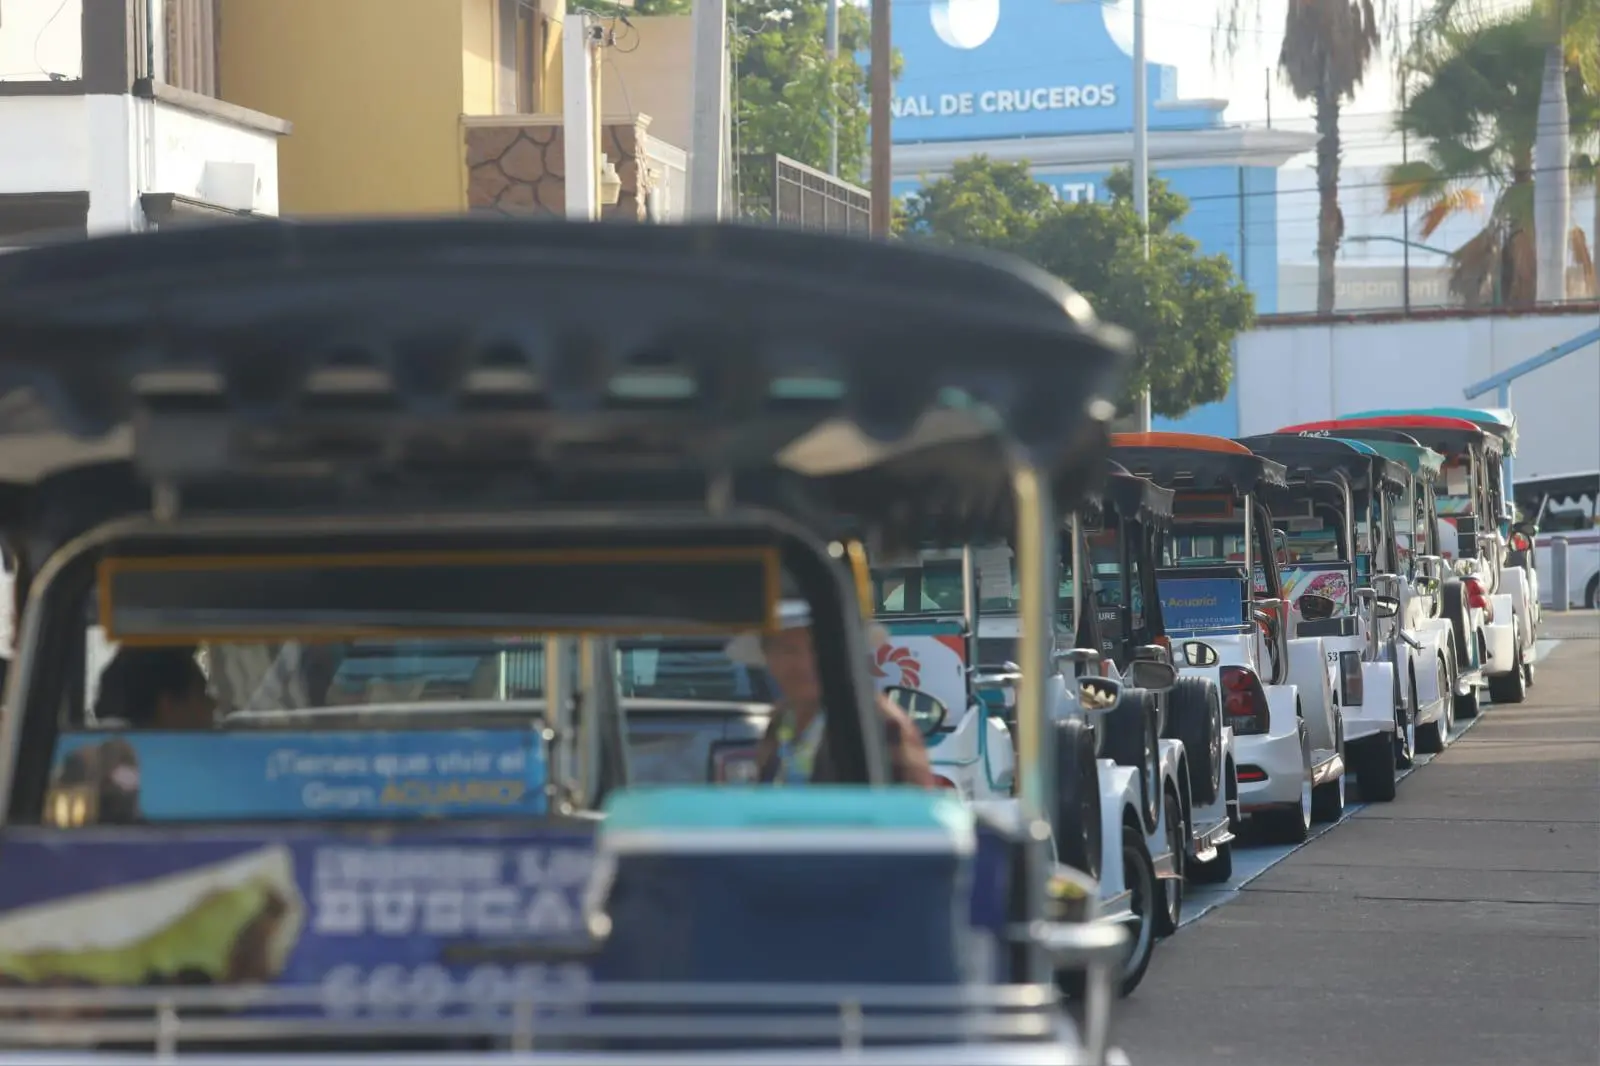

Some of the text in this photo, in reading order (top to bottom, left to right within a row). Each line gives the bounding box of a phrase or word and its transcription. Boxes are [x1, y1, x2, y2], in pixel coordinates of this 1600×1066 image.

[940, 93, 973, 116] DE
[980, 84, 1116, 112] CRUCEROS
[1327, 651, 1338, 662] 53
[374, 753, 430, 777] que
[437, 752, 492, 775] vivir
[302, 781, 374, 808] Gran
